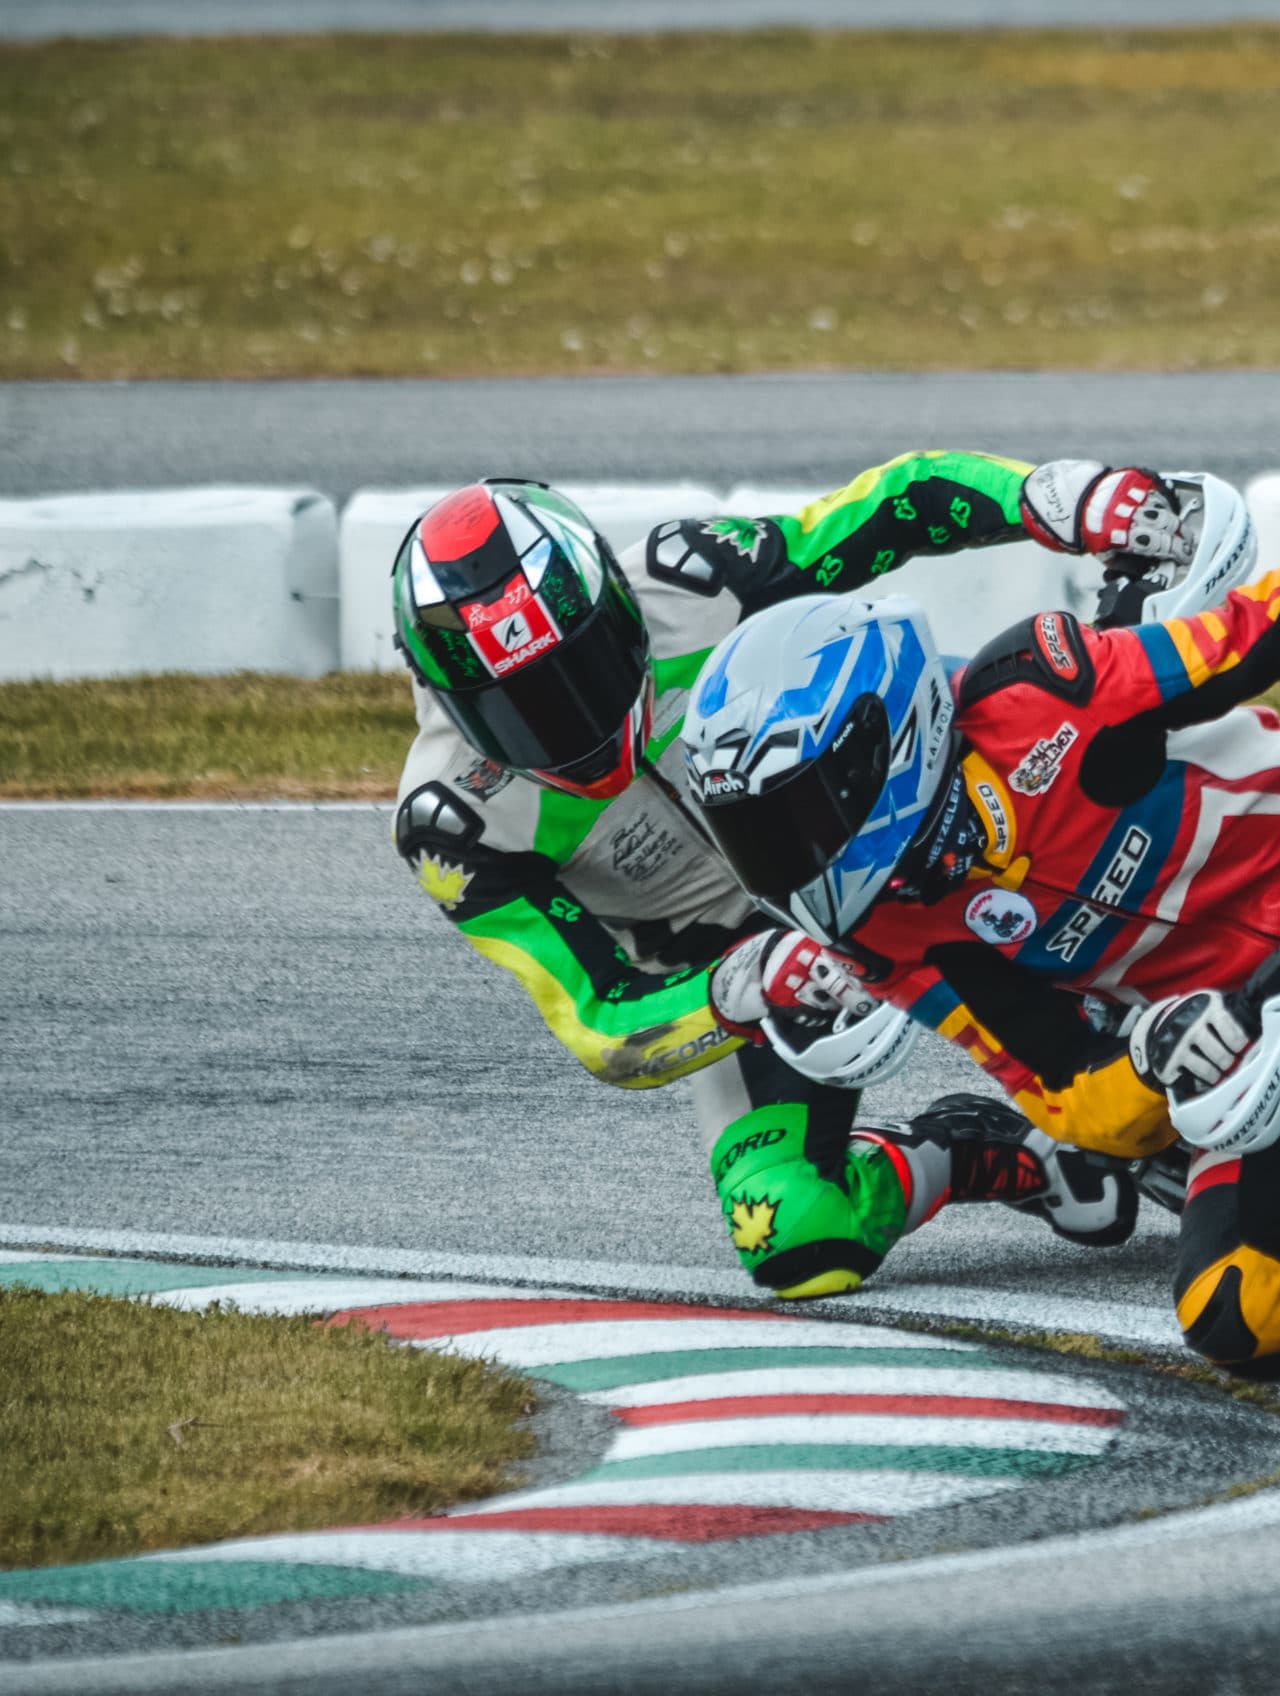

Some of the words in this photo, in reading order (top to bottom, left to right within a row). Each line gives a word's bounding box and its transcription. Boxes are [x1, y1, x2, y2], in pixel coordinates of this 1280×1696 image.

[494, 631, 556, 674] SHARK
[929, 701, 953, 757] AIROH
[703, 773, 745, 798] Airoh
[977, 783, 1010, 852] SPEED
[1046, 827, 1151, 962] SPEED
